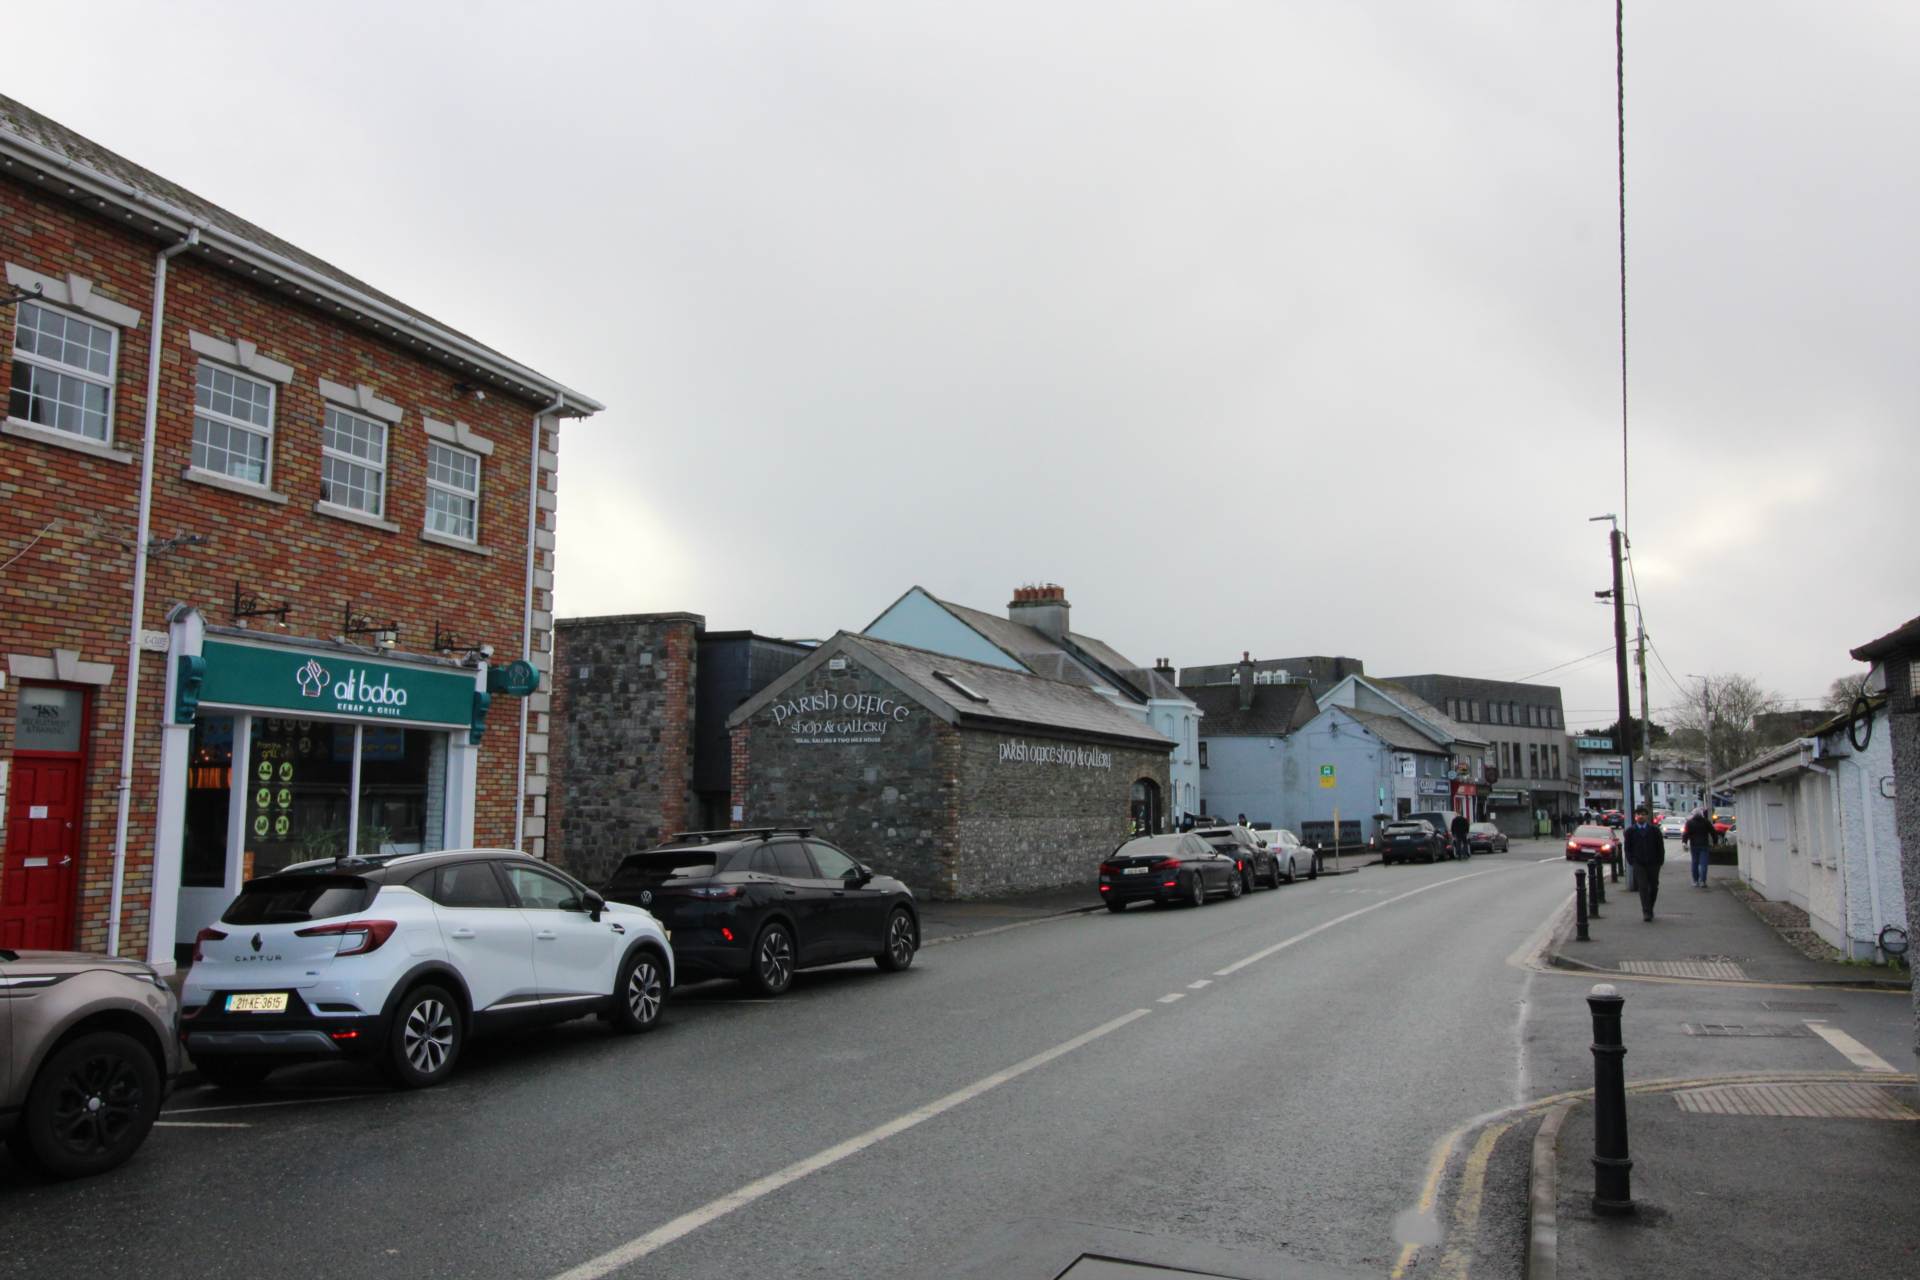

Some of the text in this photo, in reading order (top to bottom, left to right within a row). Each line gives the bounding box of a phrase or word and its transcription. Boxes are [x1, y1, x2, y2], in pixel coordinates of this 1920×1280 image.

[334, 669, 407, 705] ali baba
[337, 702, 364, 712] KEBAP
[377, 706, 401, 716] GRILL
[843, 693, 910, 722] OFFICE
[824, 720, 835, 733] &
[837, 719, 887, 735] GALLERY
[1077, 747, 1084, 766] &
